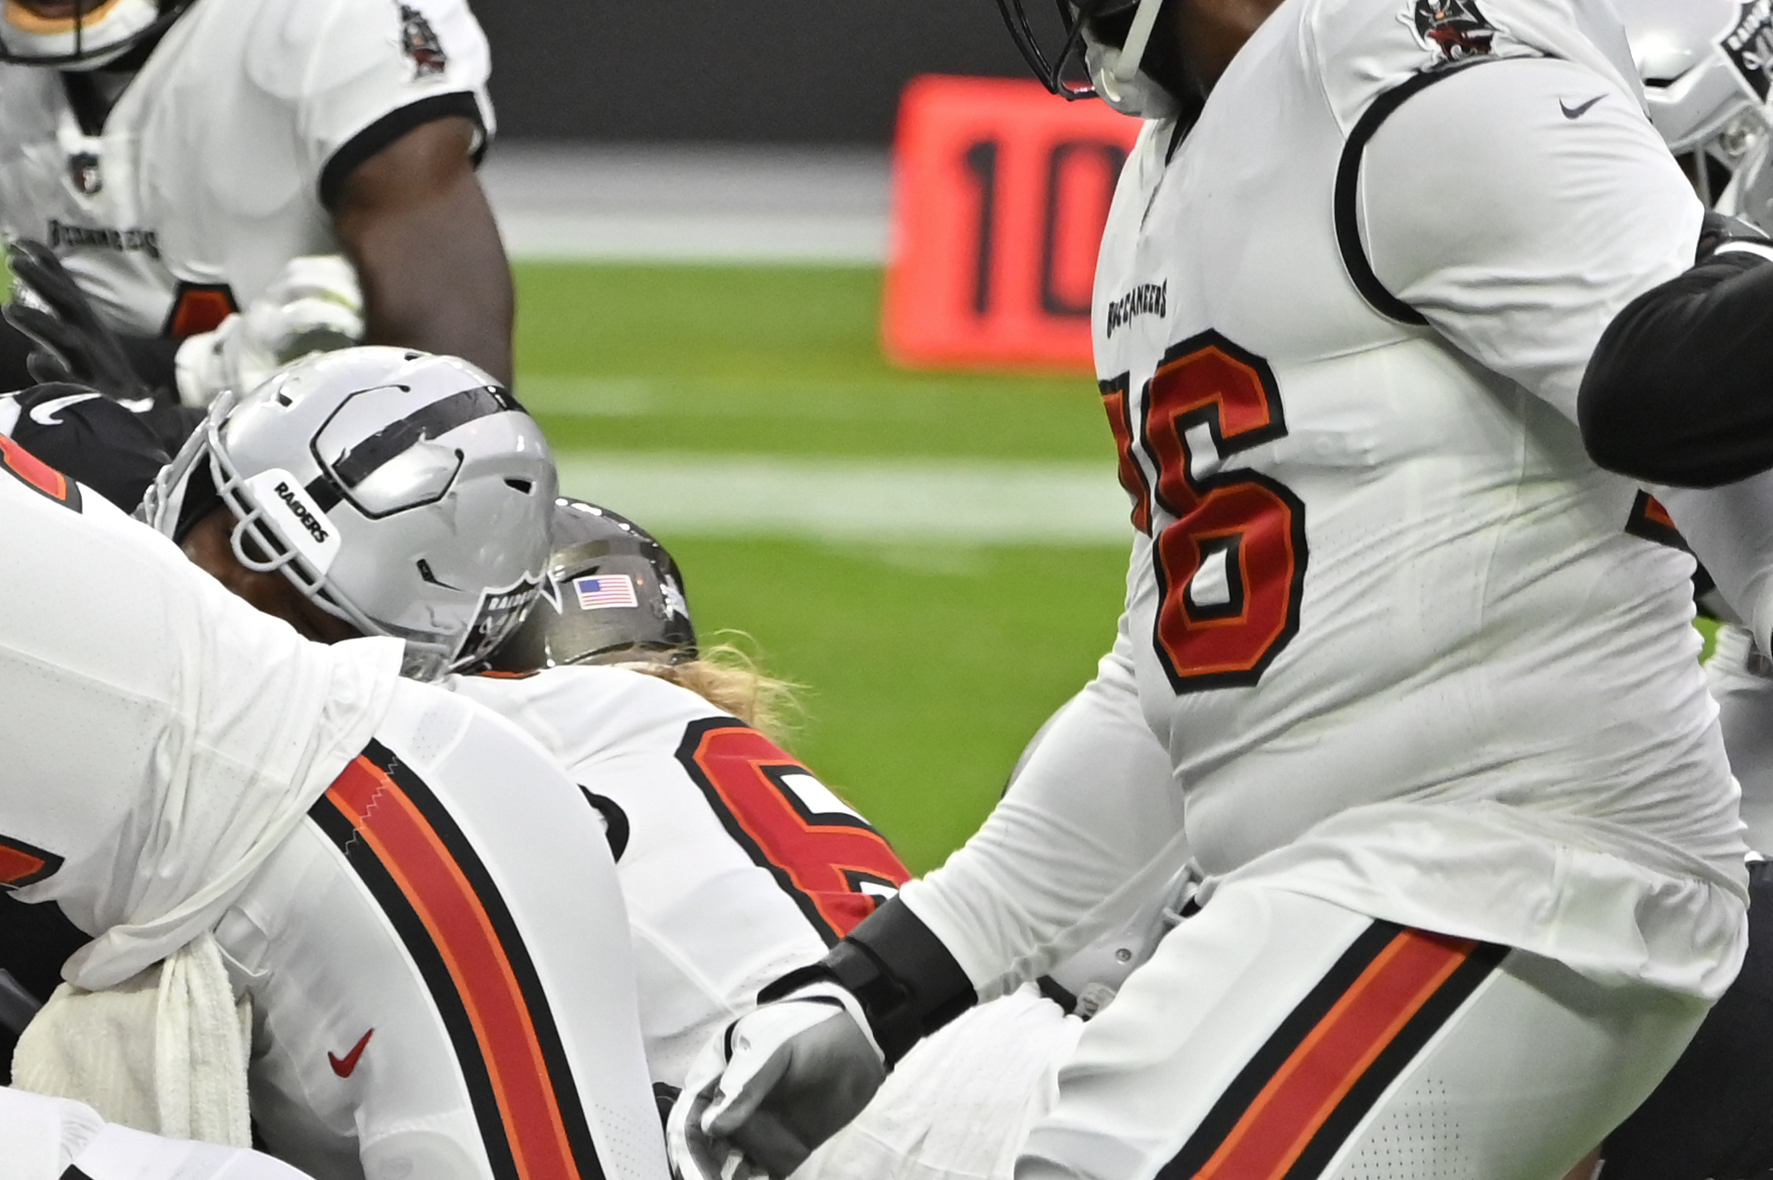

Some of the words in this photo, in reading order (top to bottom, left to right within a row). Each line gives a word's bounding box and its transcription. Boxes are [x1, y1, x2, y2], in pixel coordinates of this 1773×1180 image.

[964, 139, 1129, 318] 10
[1107, 277, 1167, 339] BUCCANEERS
[274, 481, 329, 543] RAIDERS
